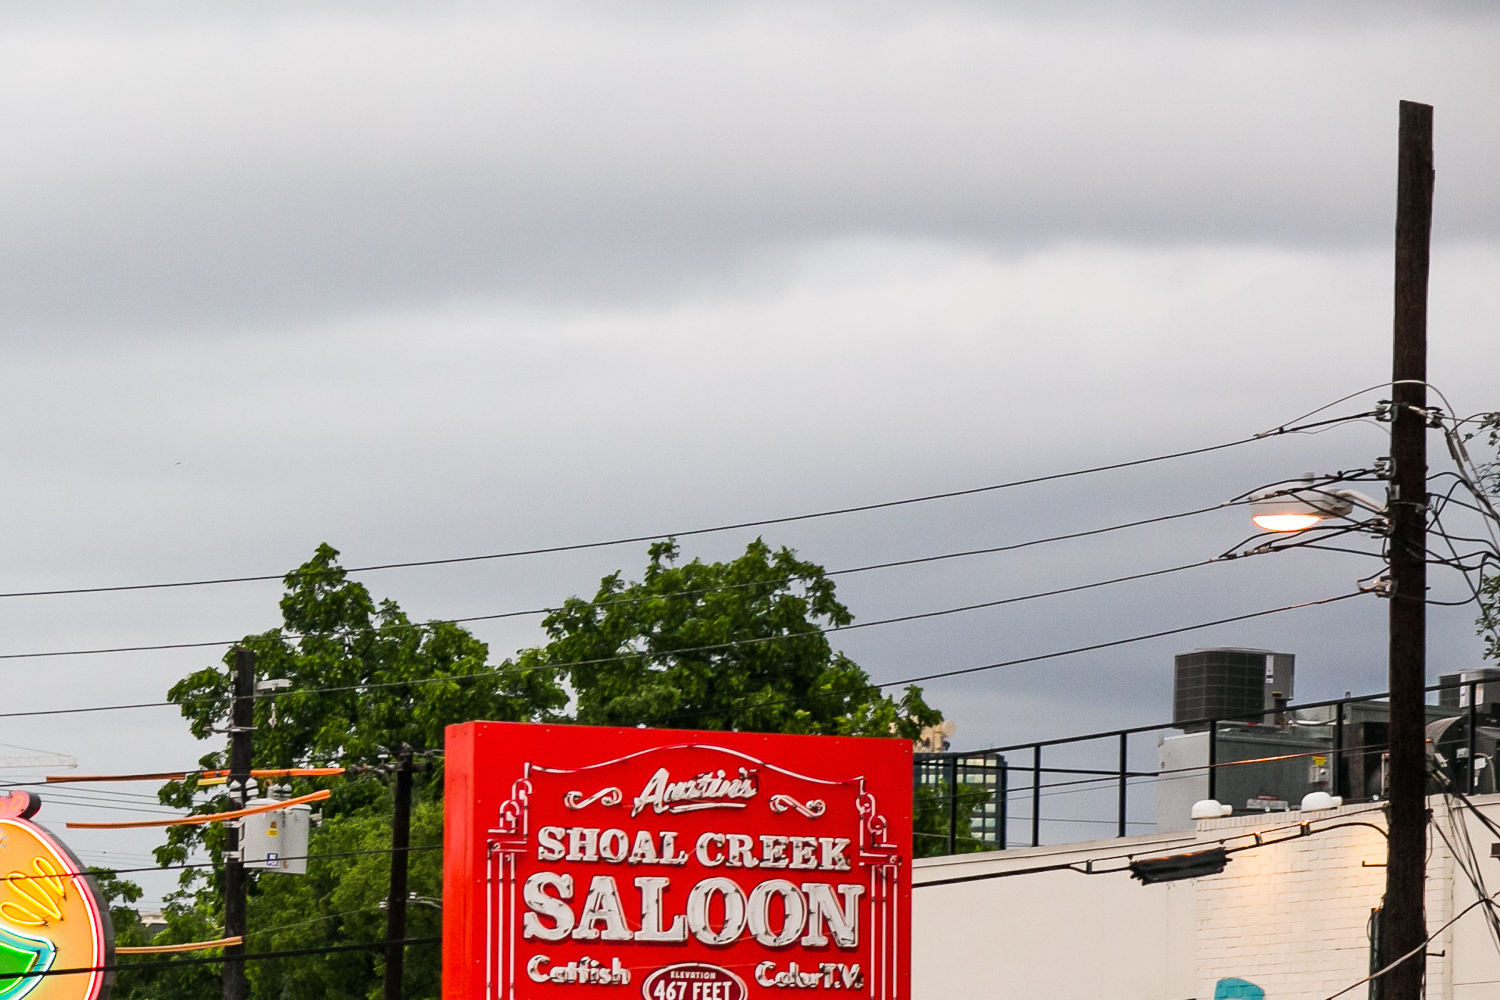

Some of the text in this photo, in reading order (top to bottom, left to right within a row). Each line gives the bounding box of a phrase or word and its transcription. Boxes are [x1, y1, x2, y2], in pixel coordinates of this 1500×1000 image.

[631, 767, 757, 817] Austin's
[537, 826, 851, 871] SHOAL CREEK
[523, 871, 866, 948] SALOON
[527, 954, 631, 988] Catfish
[670, 971, 716, 980] ELEVATION
[755, 960, 864, 989] Color T.V.
[653, 980, 687, 1000] 467
